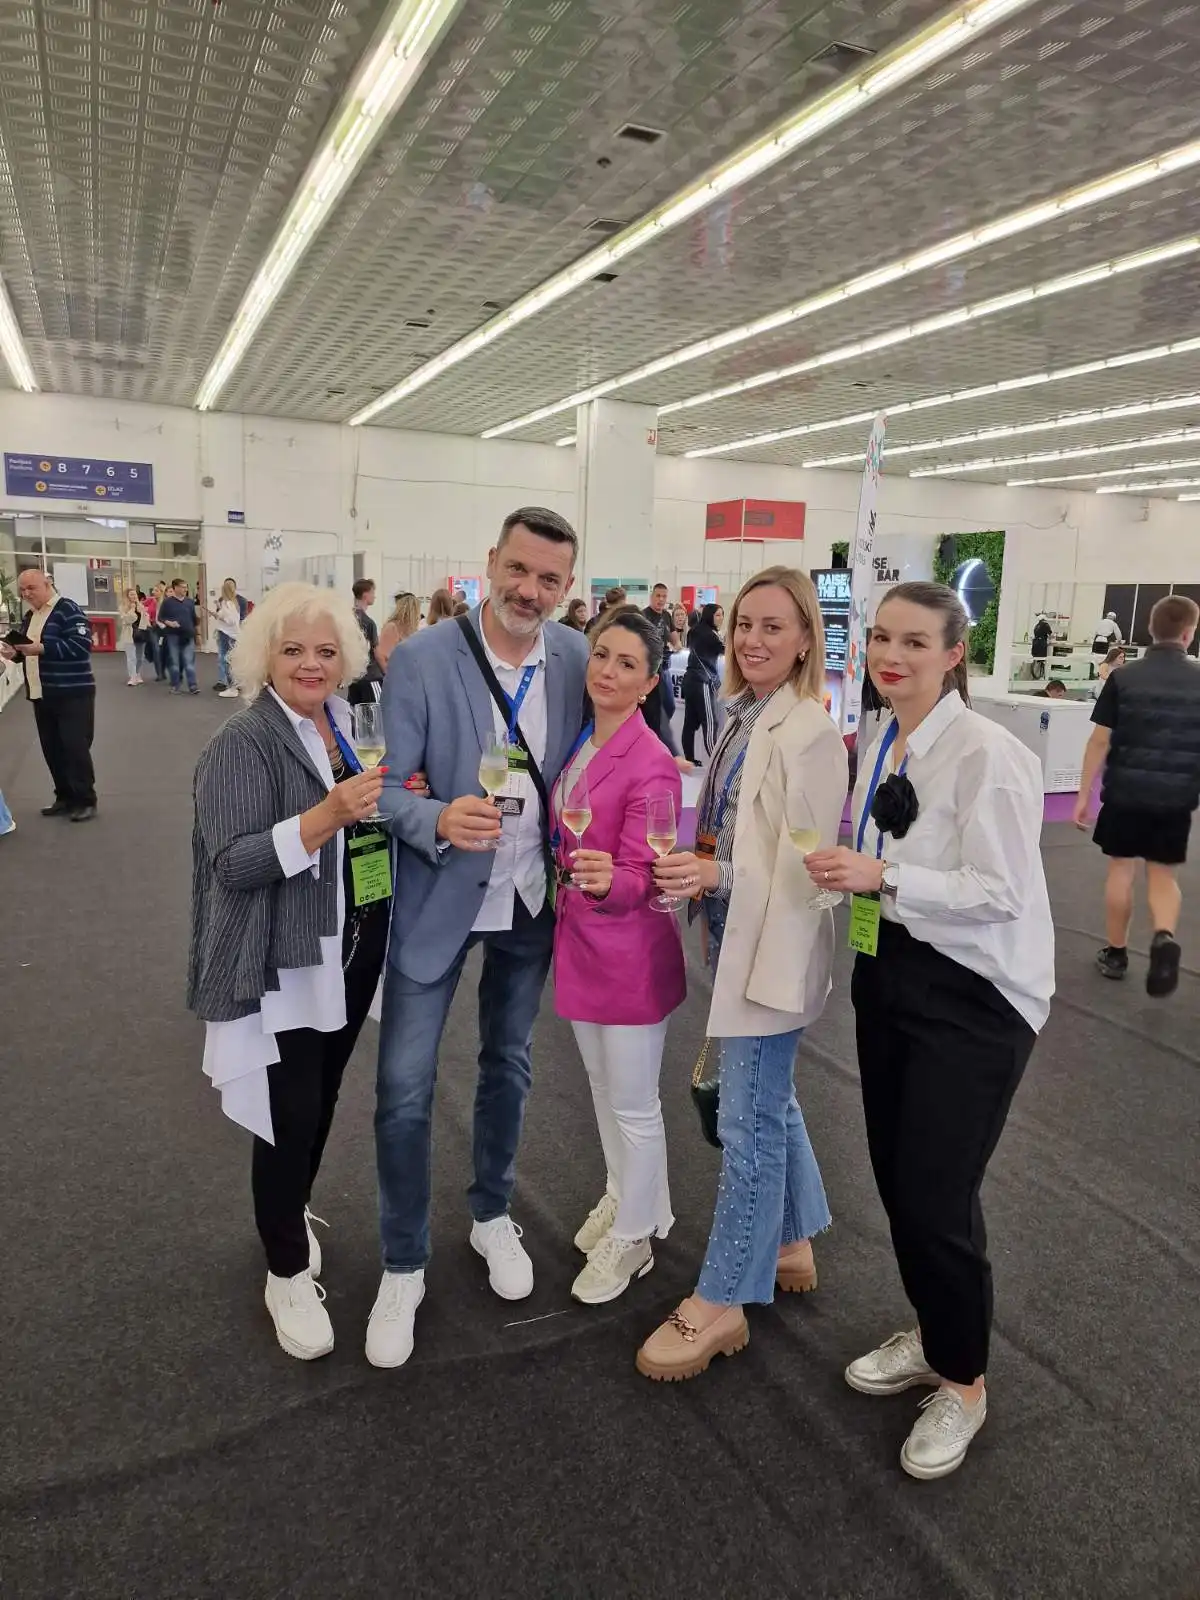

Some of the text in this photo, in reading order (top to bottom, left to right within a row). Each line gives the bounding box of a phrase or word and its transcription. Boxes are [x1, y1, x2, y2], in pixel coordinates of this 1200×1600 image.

[58, 463, 138, 478] 8 7 6 5
[877, 569, 899, 581] BAR
[818, 585, 851, 597] THE BA
